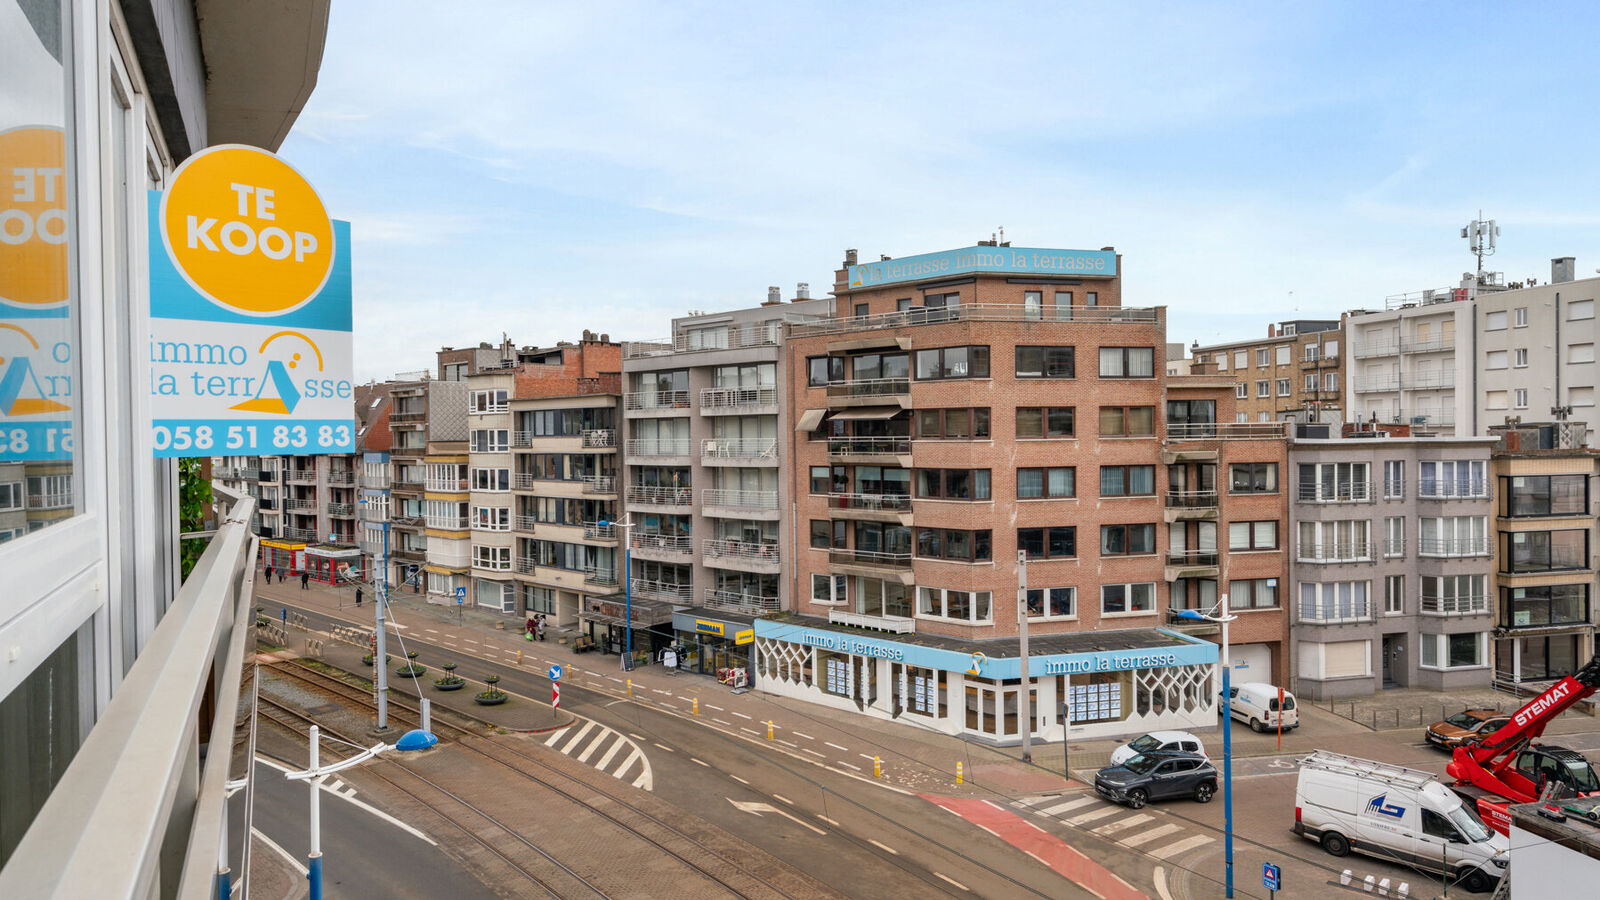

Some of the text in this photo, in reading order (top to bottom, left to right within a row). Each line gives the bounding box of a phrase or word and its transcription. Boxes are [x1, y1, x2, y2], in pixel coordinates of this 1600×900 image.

[230, 182, 276, 221] TE
[186, 215, 318, 262] KOOP
[887, 257, 950, 279] terrasse
[956, 251, 1005, 269] immo
[1011, 250, 1027, 268] la
[1033, 252, 1105, 271] terrasse
[150, 334, 247, 366] immo
[151, 368, 179, 396] la
[152, 425, 351, 450] 058 51 83 83
[696, 623, 721, 633] ZEEMAN
[802, 631, 903, 661] immo la terrasse
[1047, 653, 1176, 674] immo la terrasse
[1514, 682, 1570, 726] STEMAT
